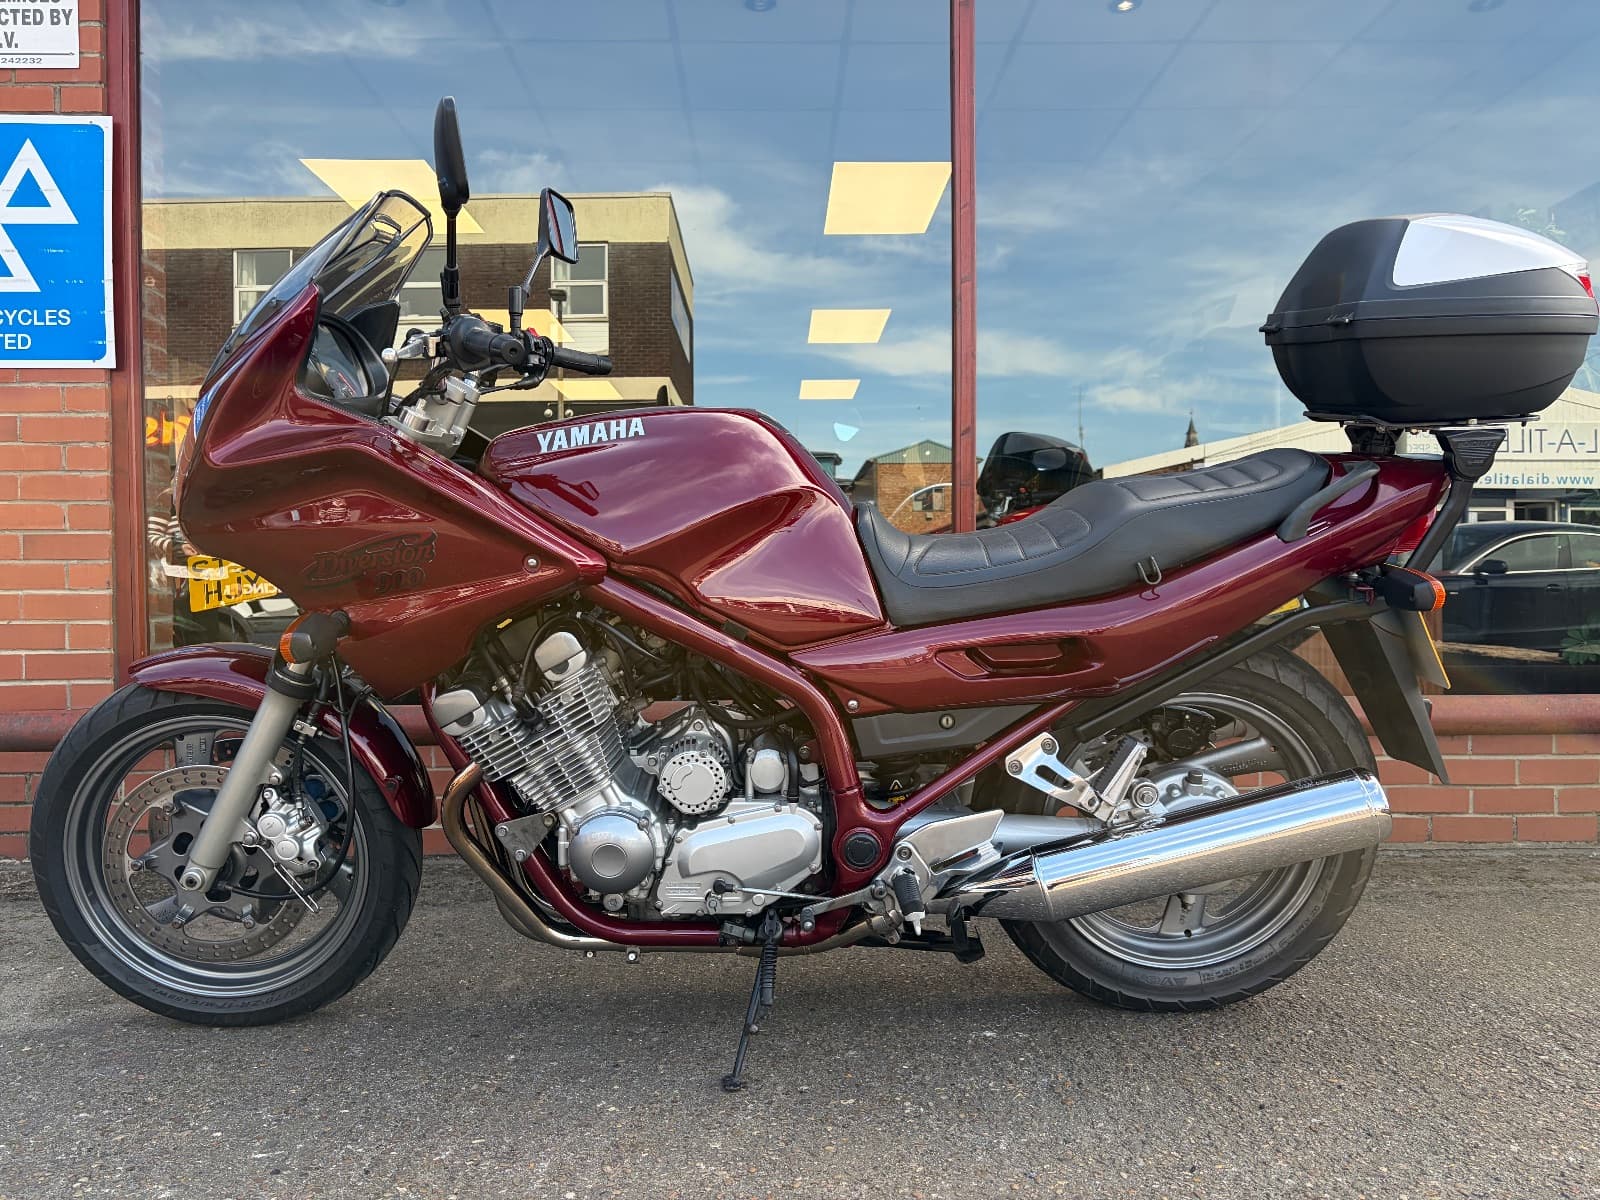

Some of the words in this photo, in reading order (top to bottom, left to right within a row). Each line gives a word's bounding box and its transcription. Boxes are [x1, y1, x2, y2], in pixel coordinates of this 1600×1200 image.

[50, 8, 73, 25] BY
[0, 308, 71, 326] YCLES
[0, 333, 32, 350] ED
[536, 416, 646, 453] YAMAHA
